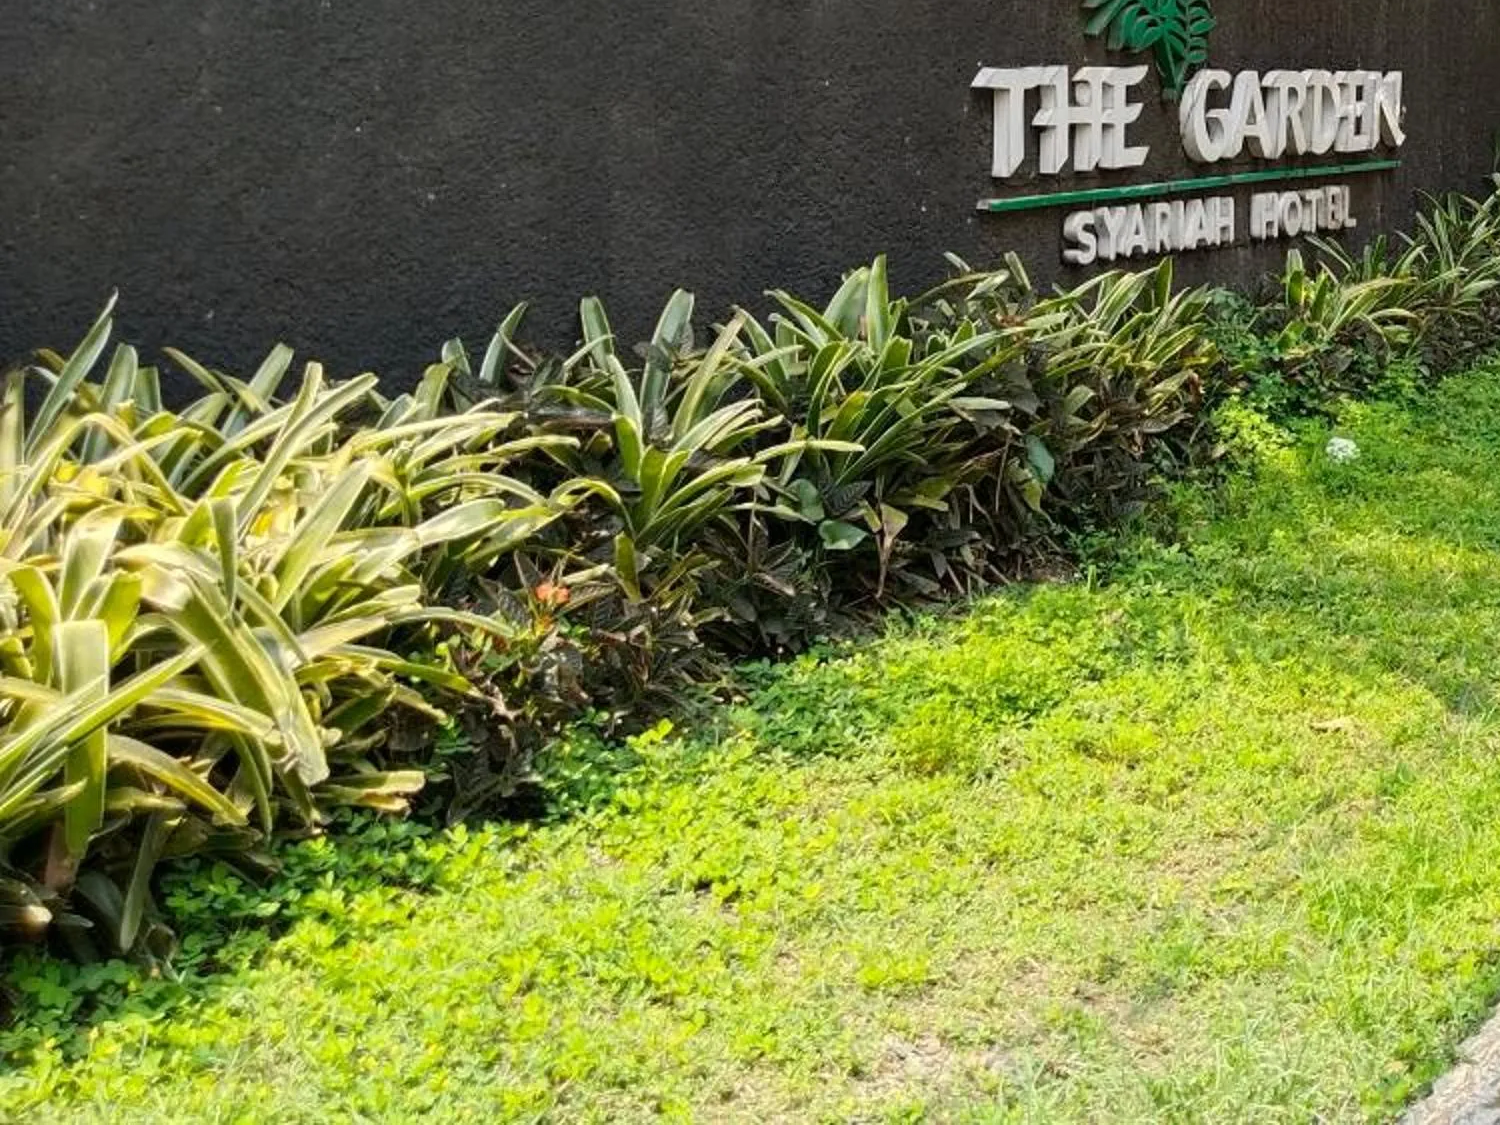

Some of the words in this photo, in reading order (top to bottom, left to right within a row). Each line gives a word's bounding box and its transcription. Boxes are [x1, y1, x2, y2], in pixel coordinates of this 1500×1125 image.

[970, 65, 1149, 177] THE
[1179, 70, 1406, 163] GARDEN
[1063, 196, 1235, 265] SYARIAH
[1251, 185, 1357, 240] HOTEL
